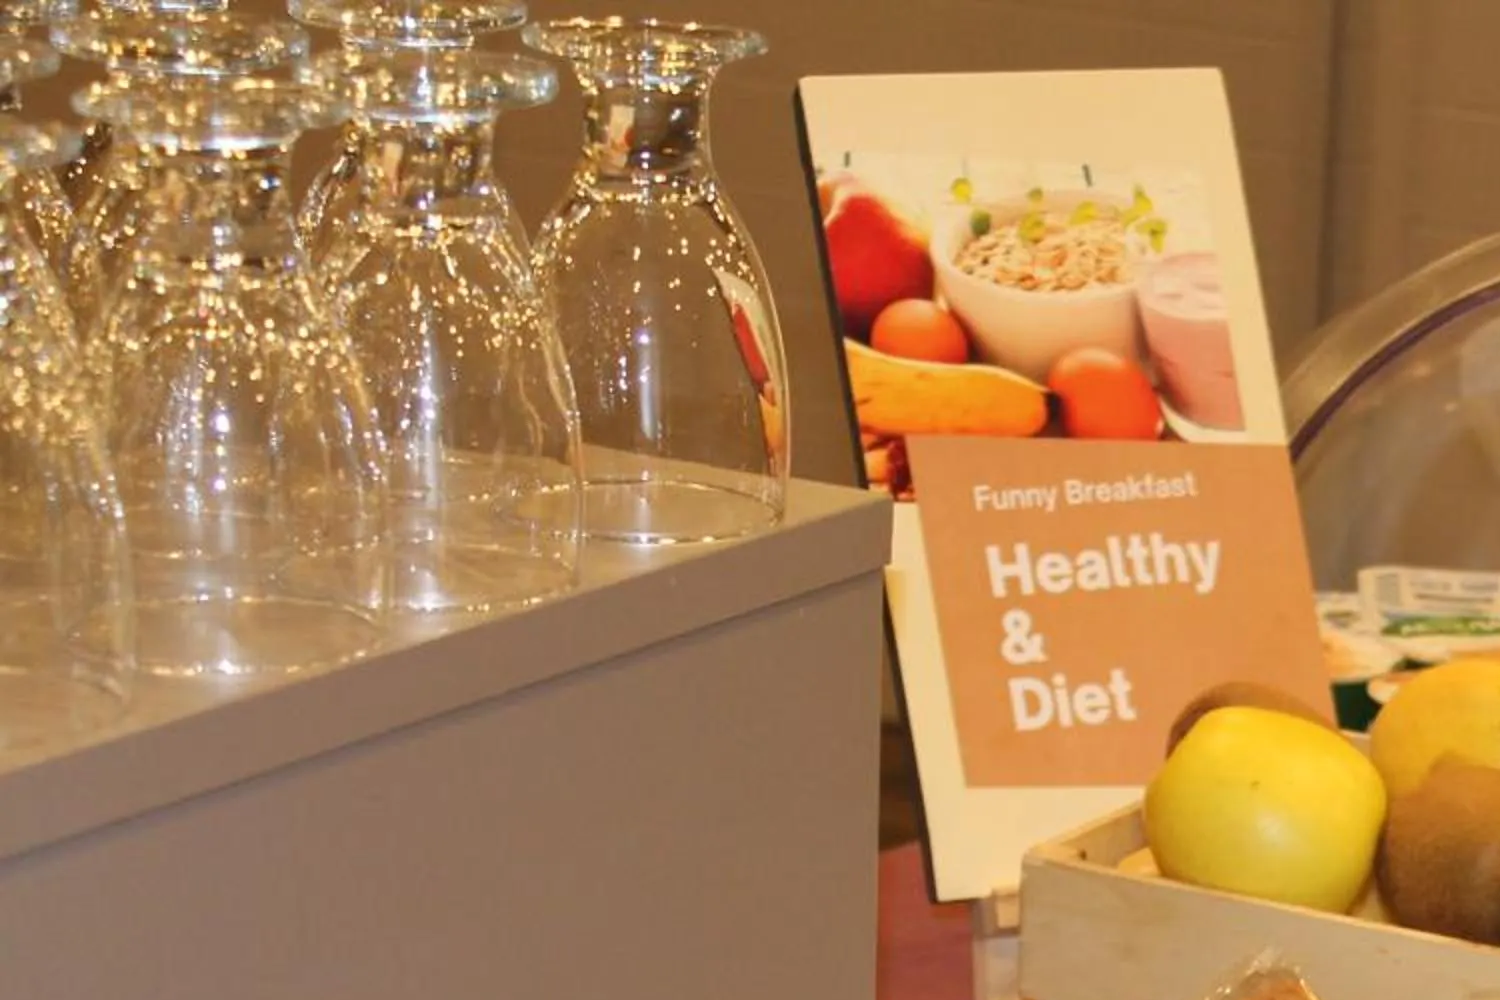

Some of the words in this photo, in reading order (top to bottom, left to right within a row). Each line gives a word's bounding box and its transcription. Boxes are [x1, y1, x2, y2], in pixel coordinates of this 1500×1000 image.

[973, 484, 1057, 512] Funny
[1064, 472, 1198, 505] Breakfast
[985, 532, 1221, 598] Healthy
[1001, 608, 1048, 665] &
[1008, 669, 1137, 732] Diet
